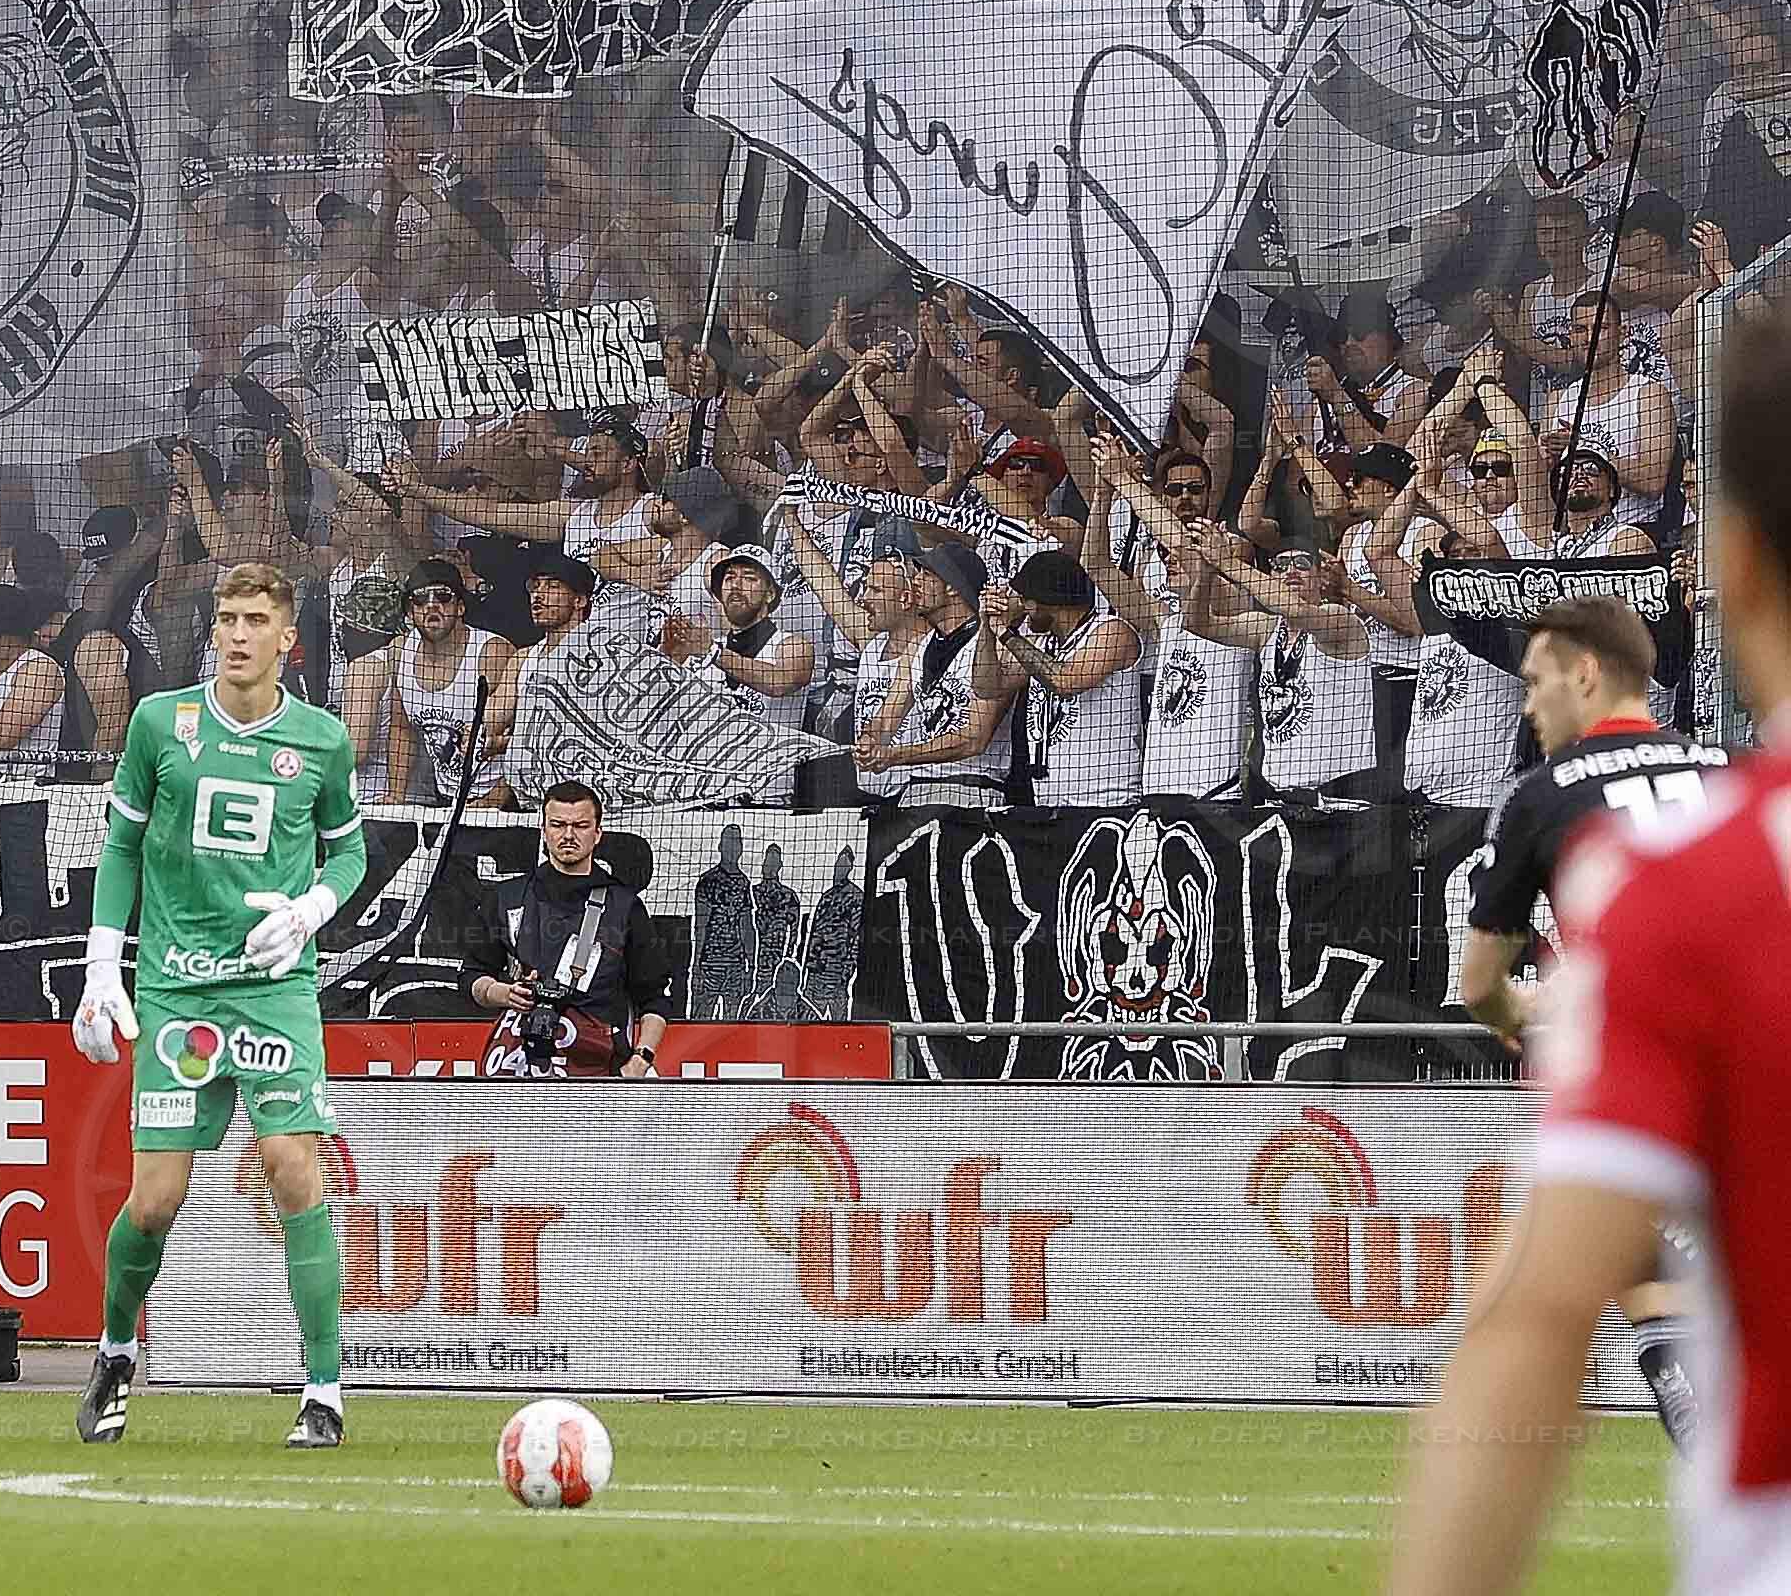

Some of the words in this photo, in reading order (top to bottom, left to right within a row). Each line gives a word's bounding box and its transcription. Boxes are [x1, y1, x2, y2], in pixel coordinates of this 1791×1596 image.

[140, 1096, 193, 1110] KLEINE
[796, 1154, 1073, 1323] wfr
[487, 1342, 569, 1373] GmbH
[800, 1345, 985, 1378] Elektrotechnik
[996, 1348, 1080, 1381] GmbH
